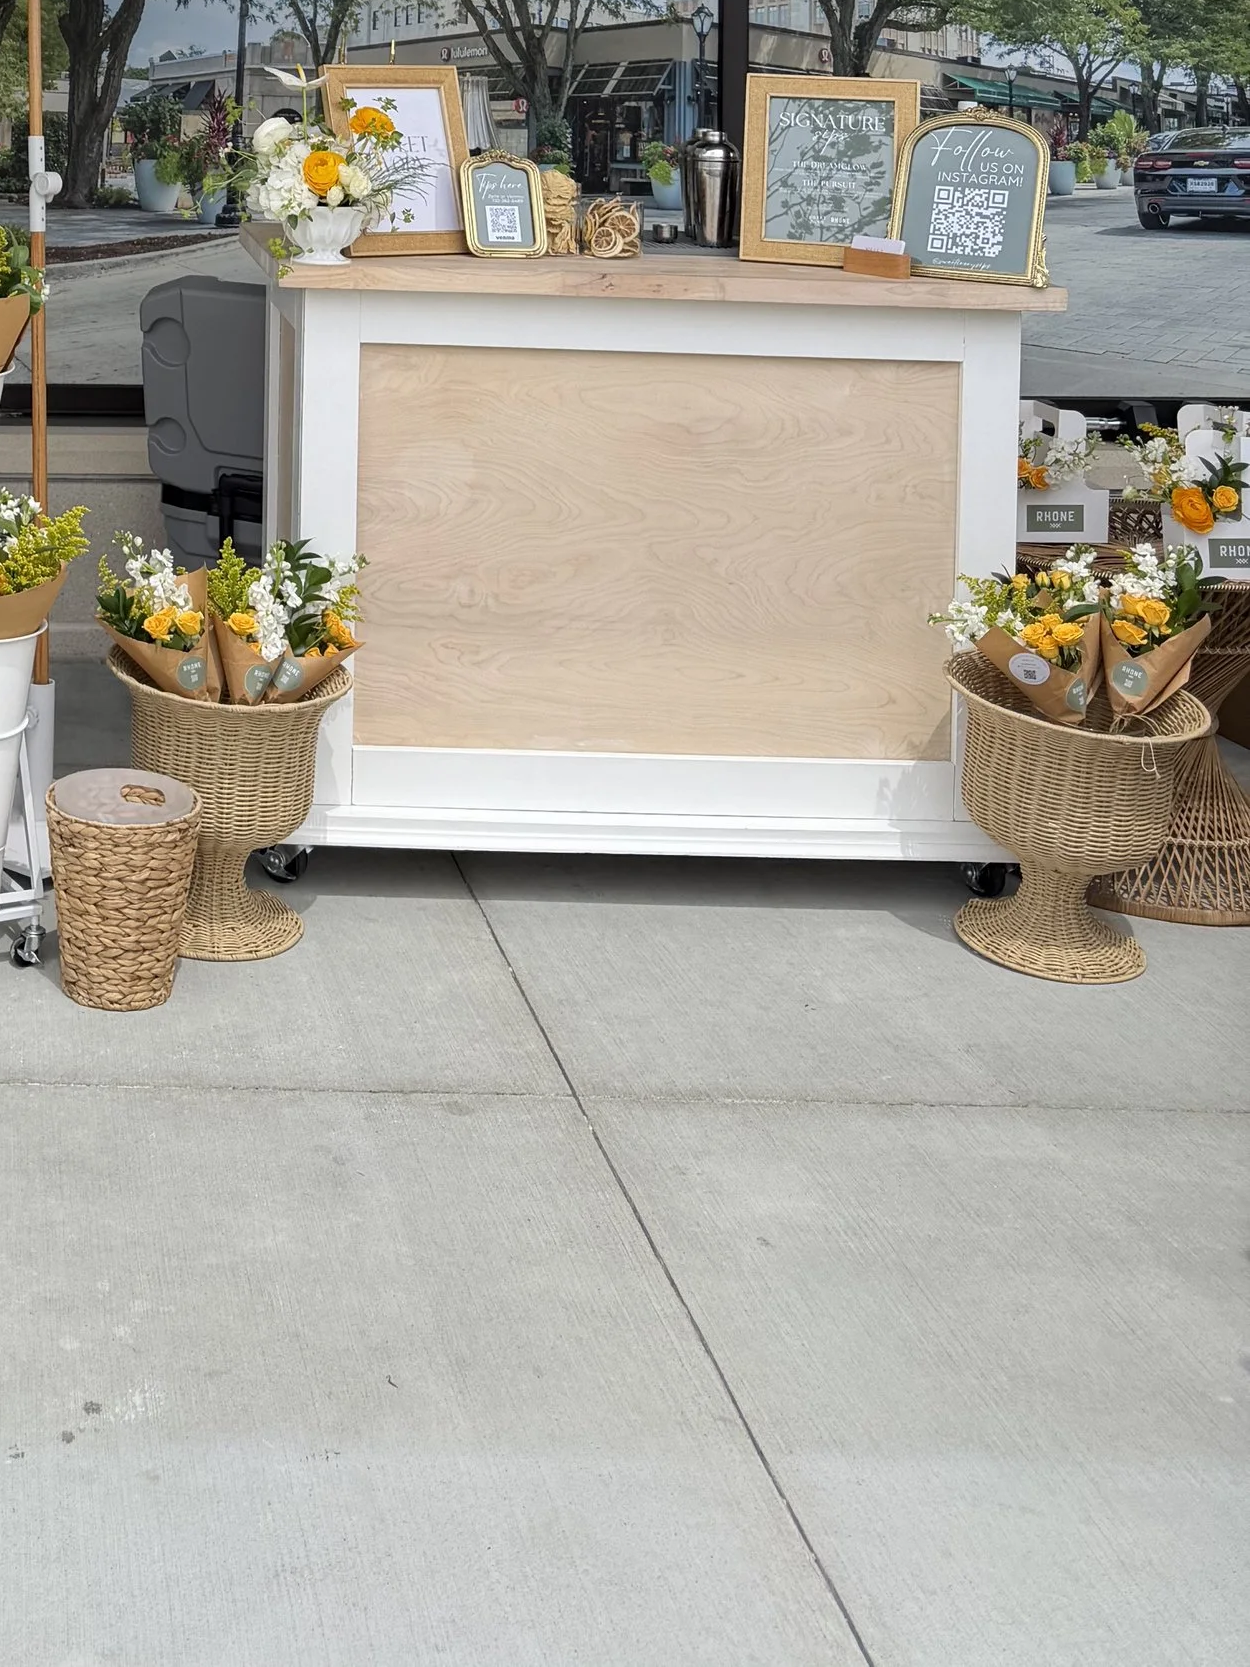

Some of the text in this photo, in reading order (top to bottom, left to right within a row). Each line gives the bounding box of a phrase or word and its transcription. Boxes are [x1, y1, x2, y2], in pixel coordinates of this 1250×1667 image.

[451, 46, 488, 60] lululemon
[779, 111, 886, 132] SIGNATURE
[928, 126, 1015, 172] Follow
[980, 162, 1025, 175] US ON
[475, 173, 522, 201] Tips here
[820, 180, 856, 189] PURSUIT
[937, 171, 1025, 188] INSTAGRAM!
[1036, 510, 1075, 522] RHONE
[1121, 664, 1144, 680] RHONE
